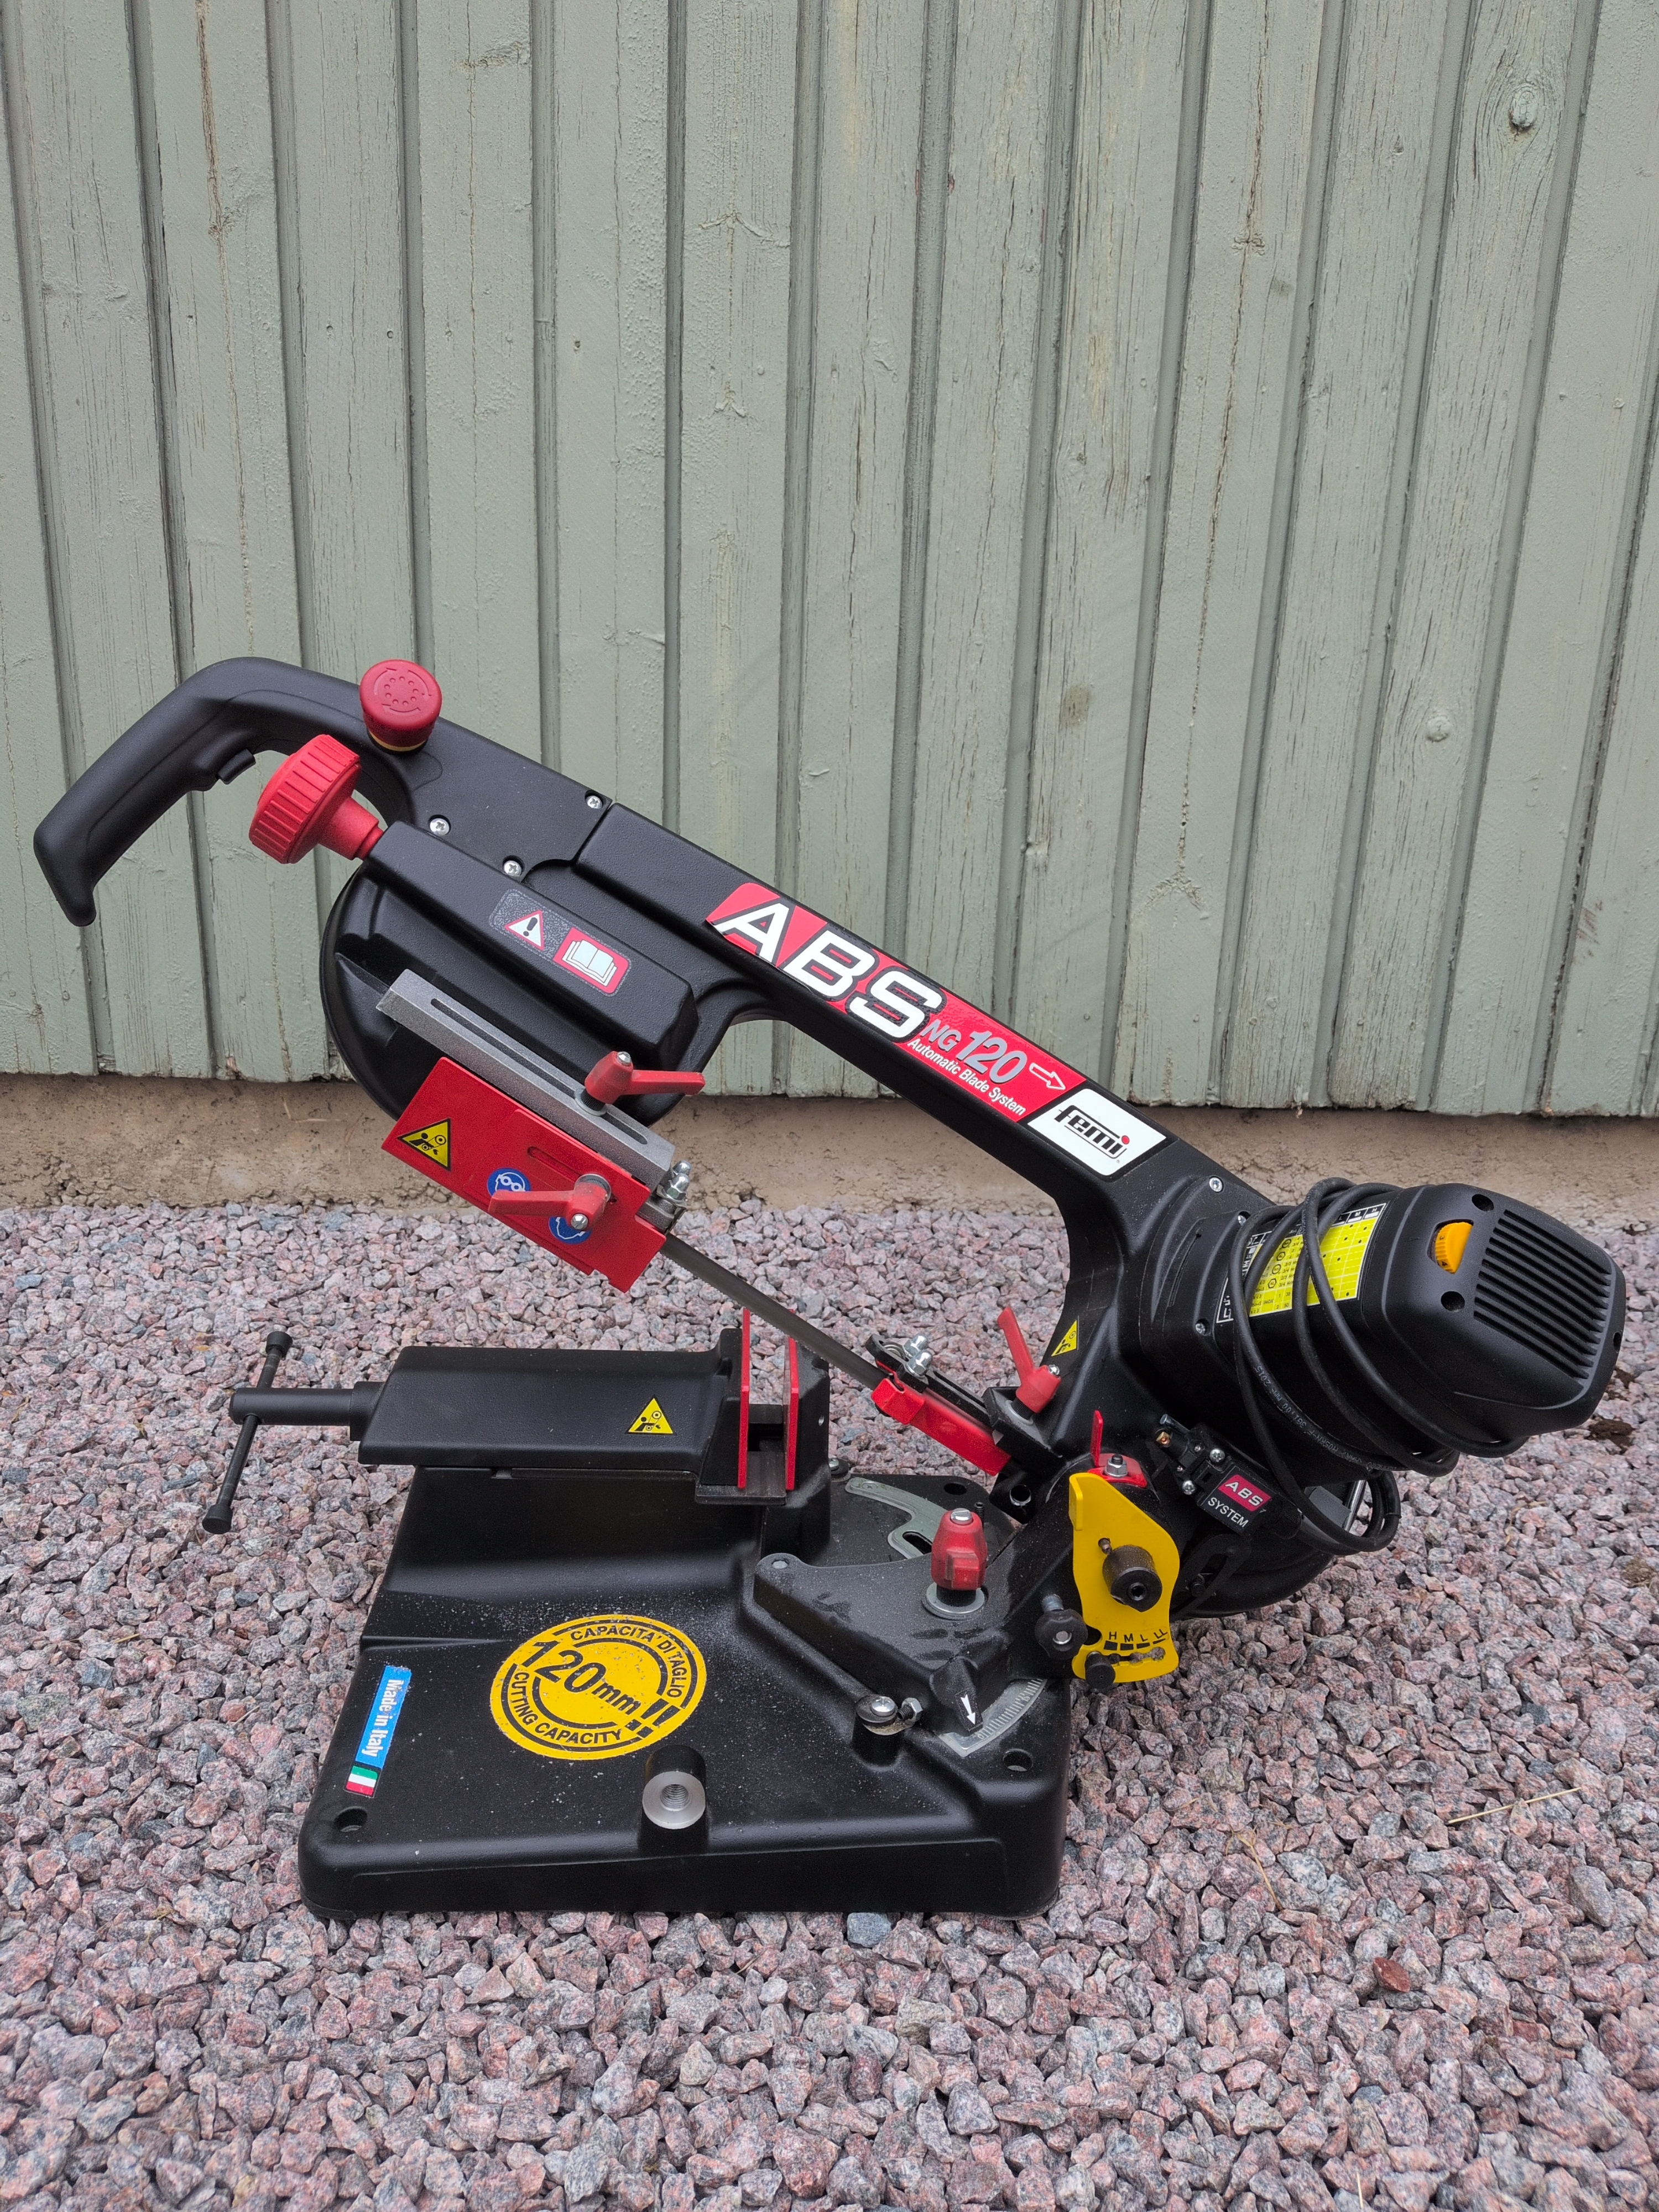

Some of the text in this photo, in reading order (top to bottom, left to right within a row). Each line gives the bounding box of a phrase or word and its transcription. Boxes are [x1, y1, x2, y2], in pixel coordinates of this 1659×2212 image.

[713, 902, 942, 1039] ABS
[907, 1038, 1026, 1116] Automatic Blade System
[920, 1019, 1027, 1084] NG 120
[1054, 1105, 1130, 1159] femi
[1253, 1365, 1272, 1387] 2015
[1208, 1497, 1249, 1528] SYSTEM
[1224, 1481, 1264, 1506] ABS
[1109, 1631, 1117, 1640] H
[1124, 1633, 1134, 1642] M
[1154, 1629, 1168, 1639] LL
[667, 1650, 688, 1698] TAGLIO
[361, 1679, 404, 1757] Made in Italy
[511, 1672, 623, 1745] CUTTING CAPACITY
